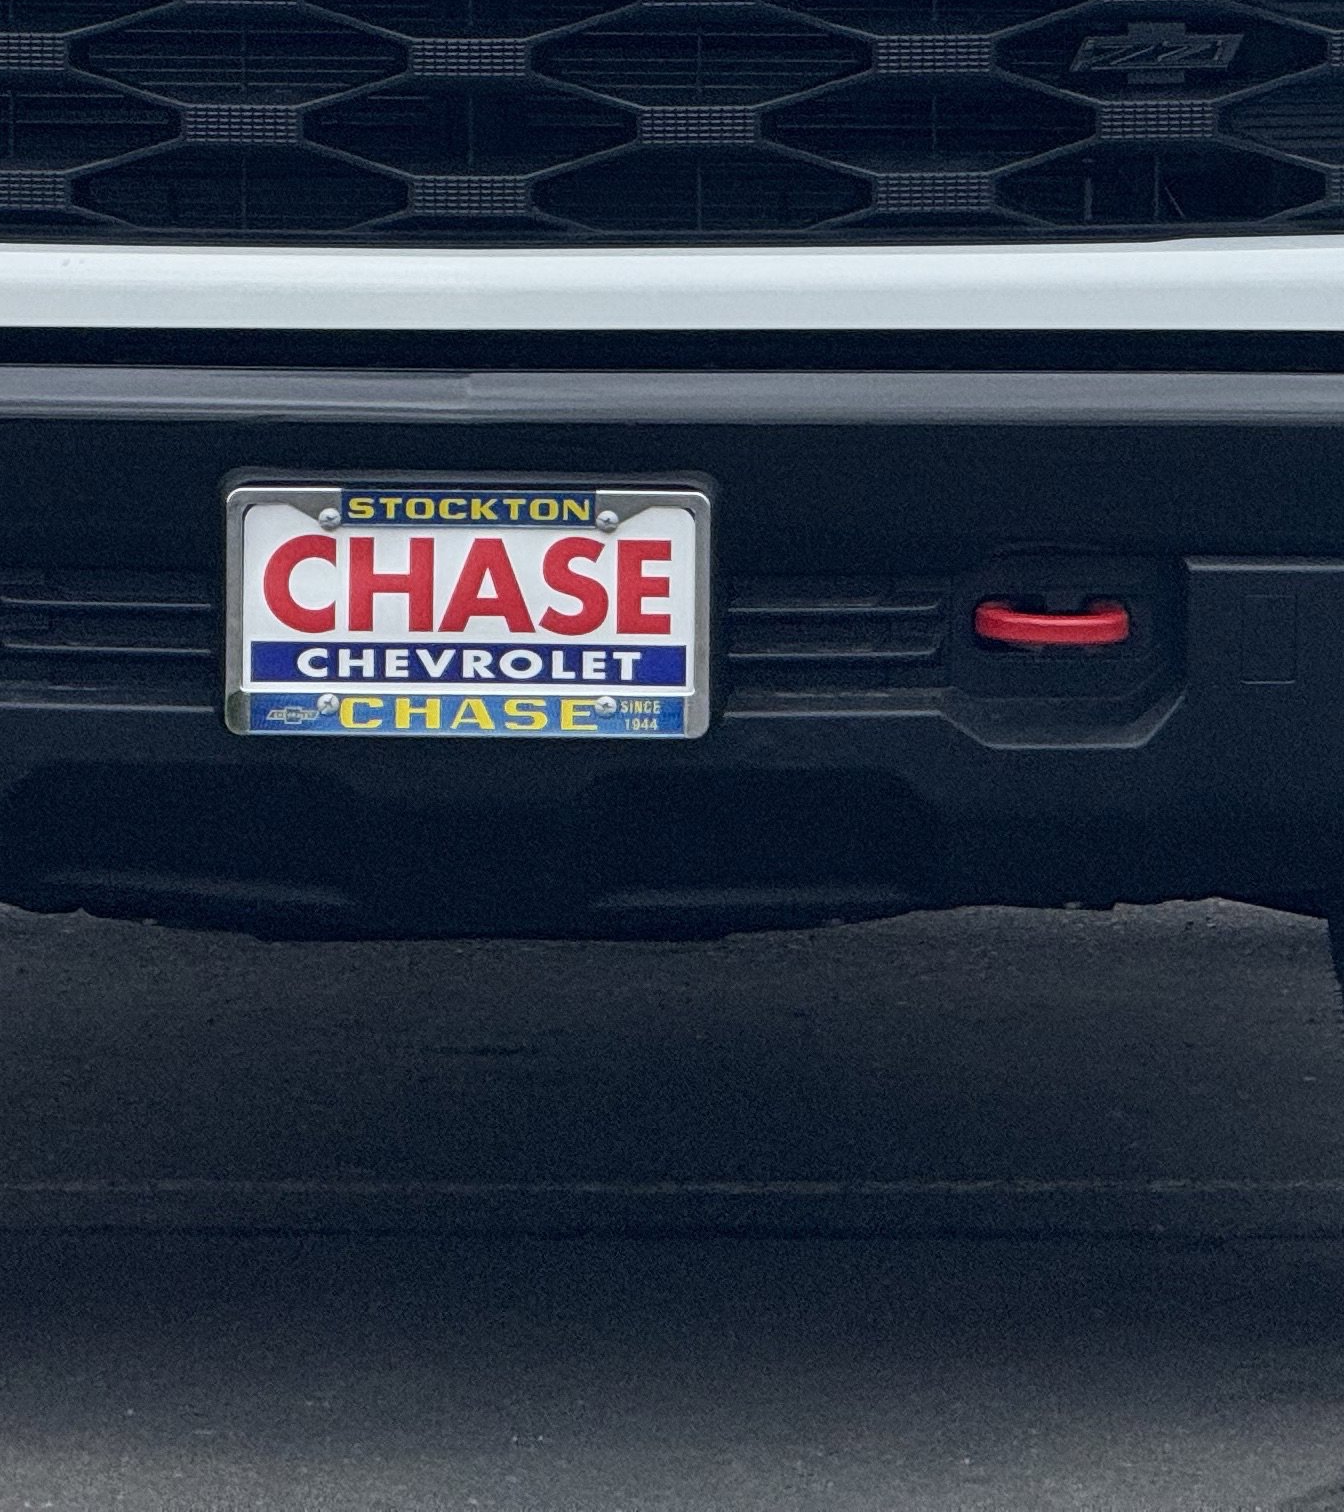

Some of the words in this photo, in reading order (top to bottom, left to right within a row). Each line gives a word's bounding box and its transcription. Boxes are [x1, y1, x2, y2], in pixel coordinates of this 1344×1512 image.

[348, 496, 591, 522] STOCKTON
[263, 534, 672, 635] CHASE
[296, 648, 641, 681] CHEVROLET
[339, 696, 599, 732] CHASE
[620, 700, 661, 715] SINCE
[624, 717, 658, 731] 1944
